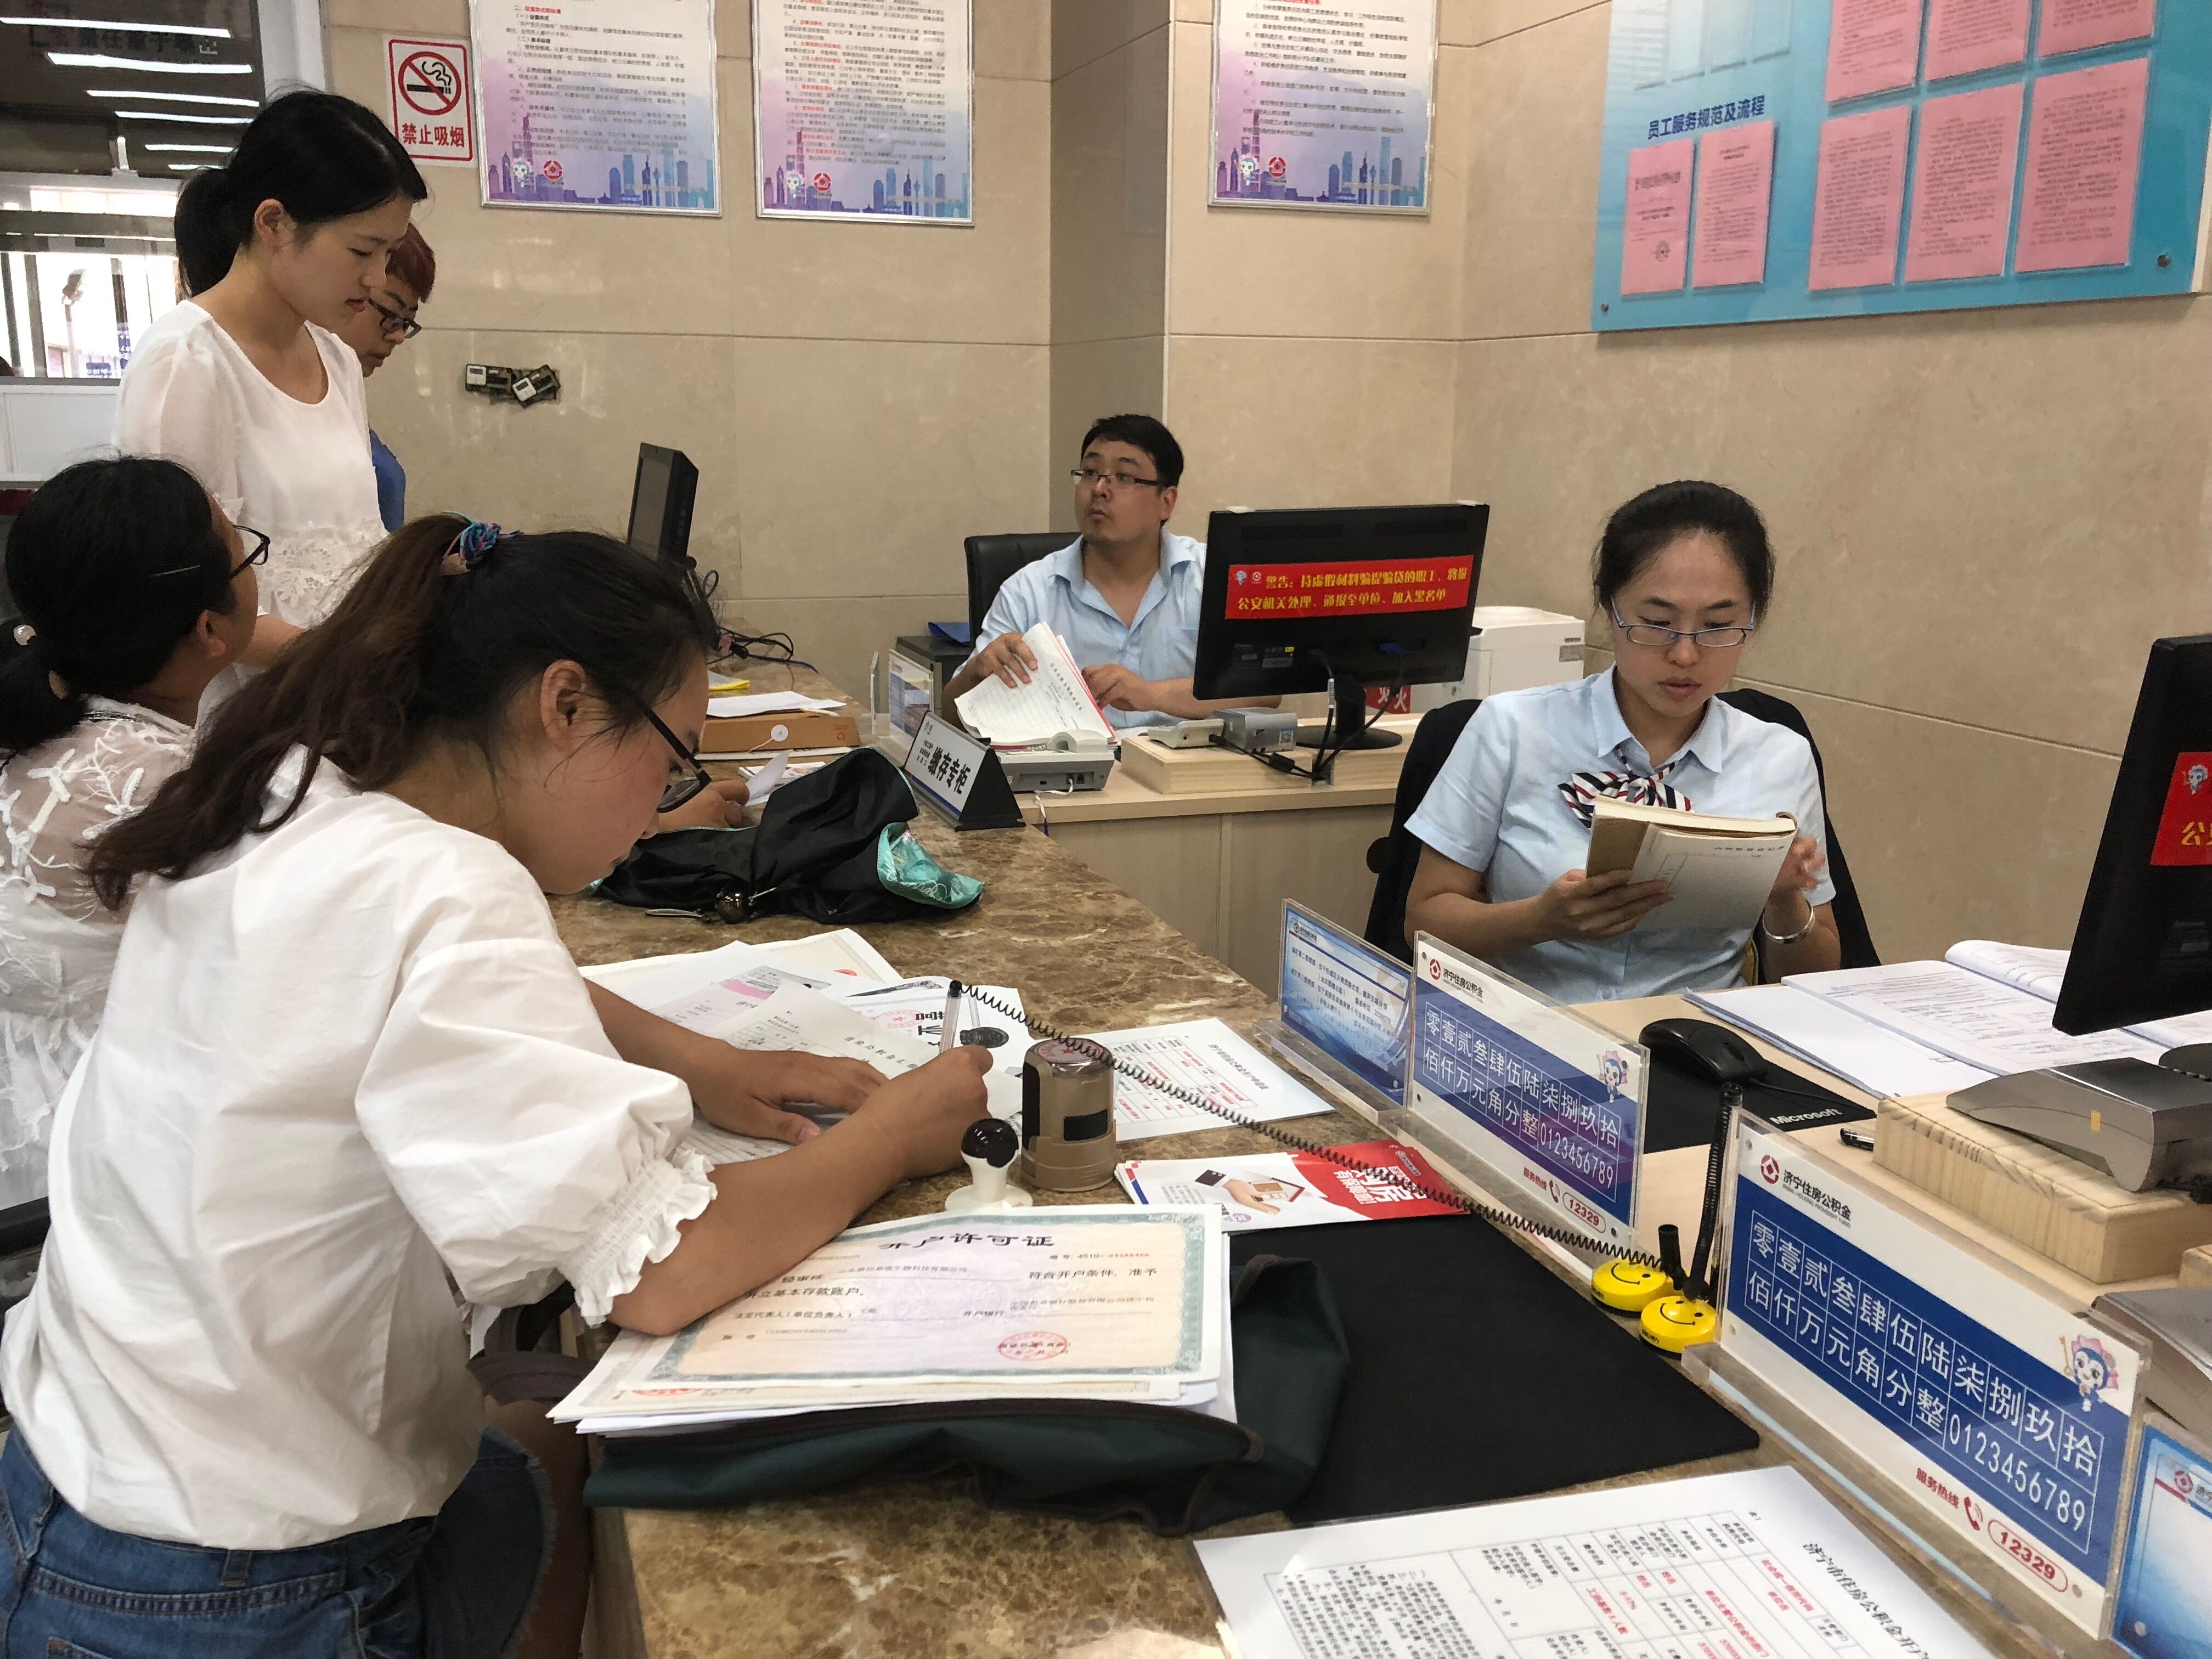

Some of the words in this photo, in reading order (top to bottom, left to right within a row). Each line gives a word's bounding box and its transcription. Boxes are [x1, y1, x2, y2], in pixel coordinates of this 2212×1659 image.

[402, 123, 464, 148] 禁止吸烟
[1648, 95, 1765, 140] 员工服务规范及流程
[927, 746, 971, 795] 缴存专柜
[1443, 968, 1483, 998] 济宁住房公积金
[1426, 1009, 1620, 1148] 零壹贰叁肆伍陆柒捌玖拾
[1769, 1108, 1843, 1124] Microsoft
[1523, 1166, 1547, 1191] 服务热线
[1569, 1199, 1599, 1226] 12329
[1783, 1170, 1852, 1221] 济宁住房公积金
[878, 1232, 1055, 1249] 开户许可证
[1753, 1221, 2097, 1477] 零壹贰叁肆伍陆柒捌玖拾
[1916, 1468, 1959, 1509] 服务热线
[2000, 1532, 2056, 1579] 12329
